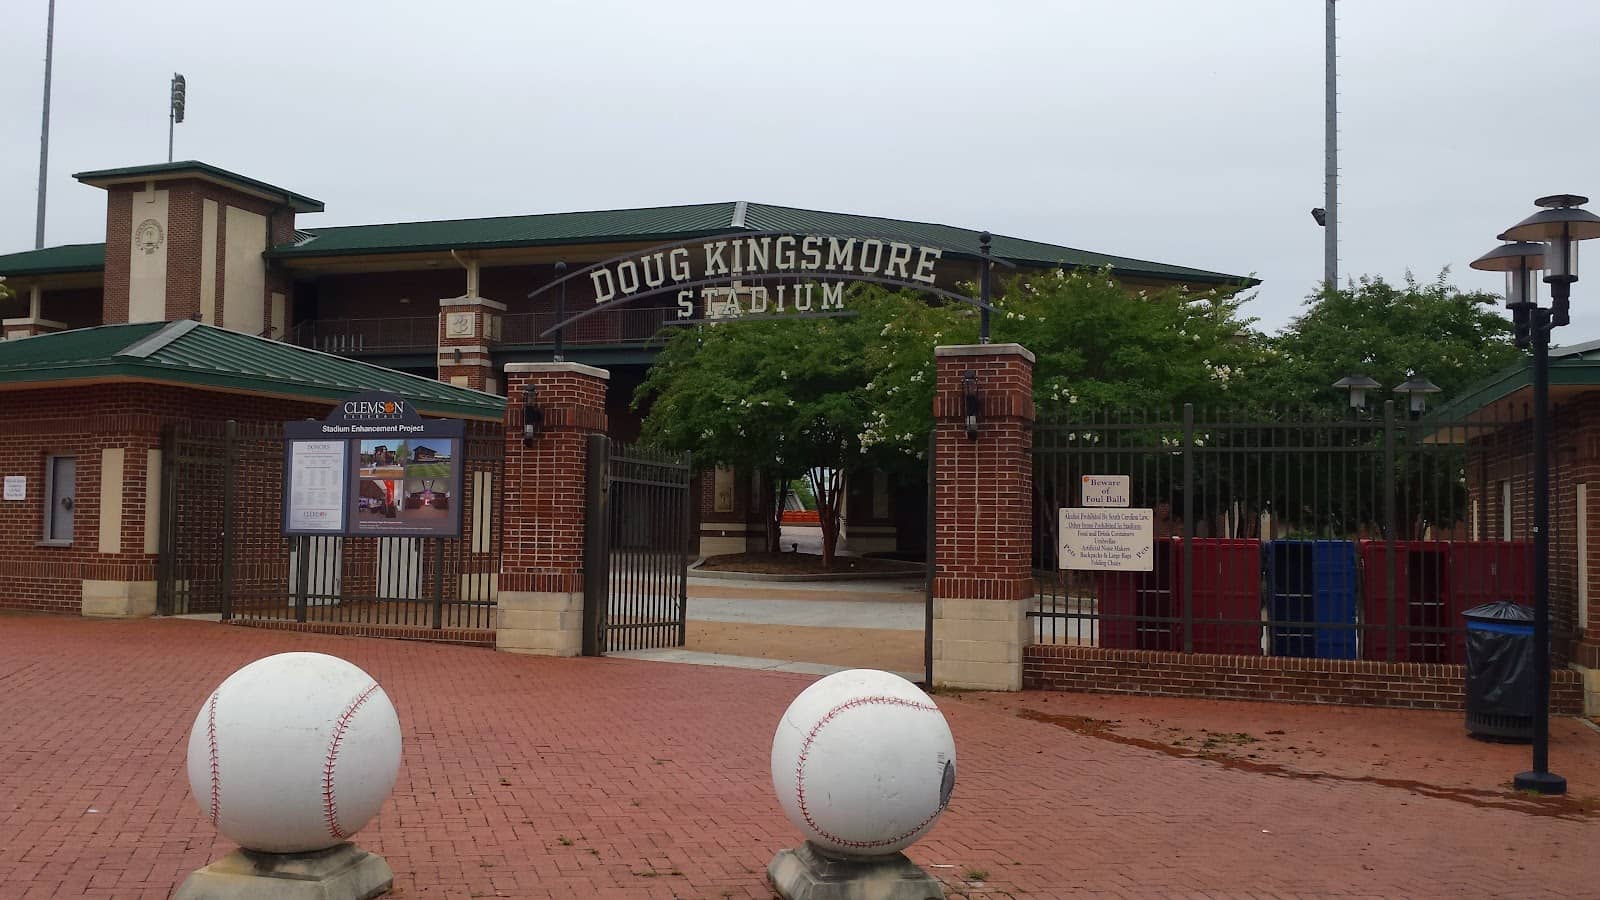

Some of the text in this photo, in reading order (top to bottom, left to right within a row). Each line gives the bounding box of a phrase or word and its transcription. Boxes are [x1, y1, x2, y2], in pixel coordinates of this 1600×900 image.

[590, 235, 942, 304] DOUG KINGSMORE
[677, 281, 845, 319] STADIUM
[344, 401, 404, 414] CLEMSON
[322, 424, 424, 433] Stadium Enhancement Project
[1101, 487, 1110, 495] of
